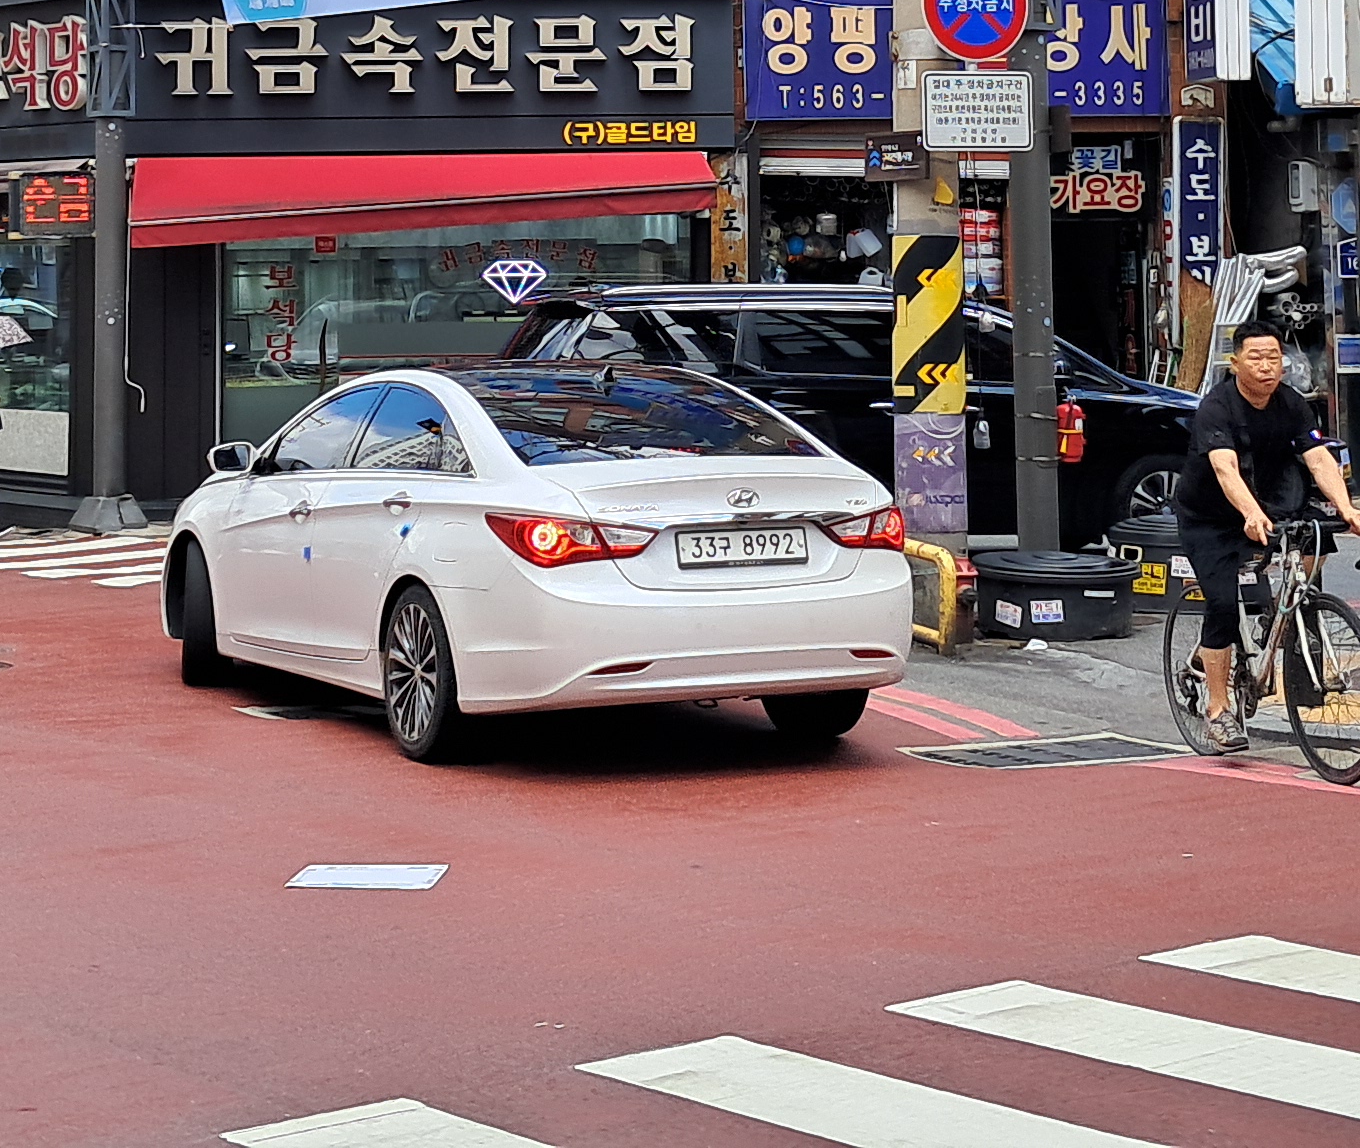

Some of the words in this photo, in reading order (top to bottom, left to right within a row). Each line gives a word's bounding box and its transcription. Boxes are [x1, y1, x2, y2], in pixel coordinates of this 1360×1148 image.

[155, 12, 696, 94] 귀금속전문점
[763, 6, 876, 74] 양평
[561, 119, 697, 146] (구)골드타임
[1073, 145, 1121, 172] 꽃길
[22, 176, 91, 223] 순금
[1051, 173, 1143, 211] 가요장
[264, 263, 299, 363] 보석당
[691, 535, 733, 561] 33구
[742, 533, 796, 557] 8992
